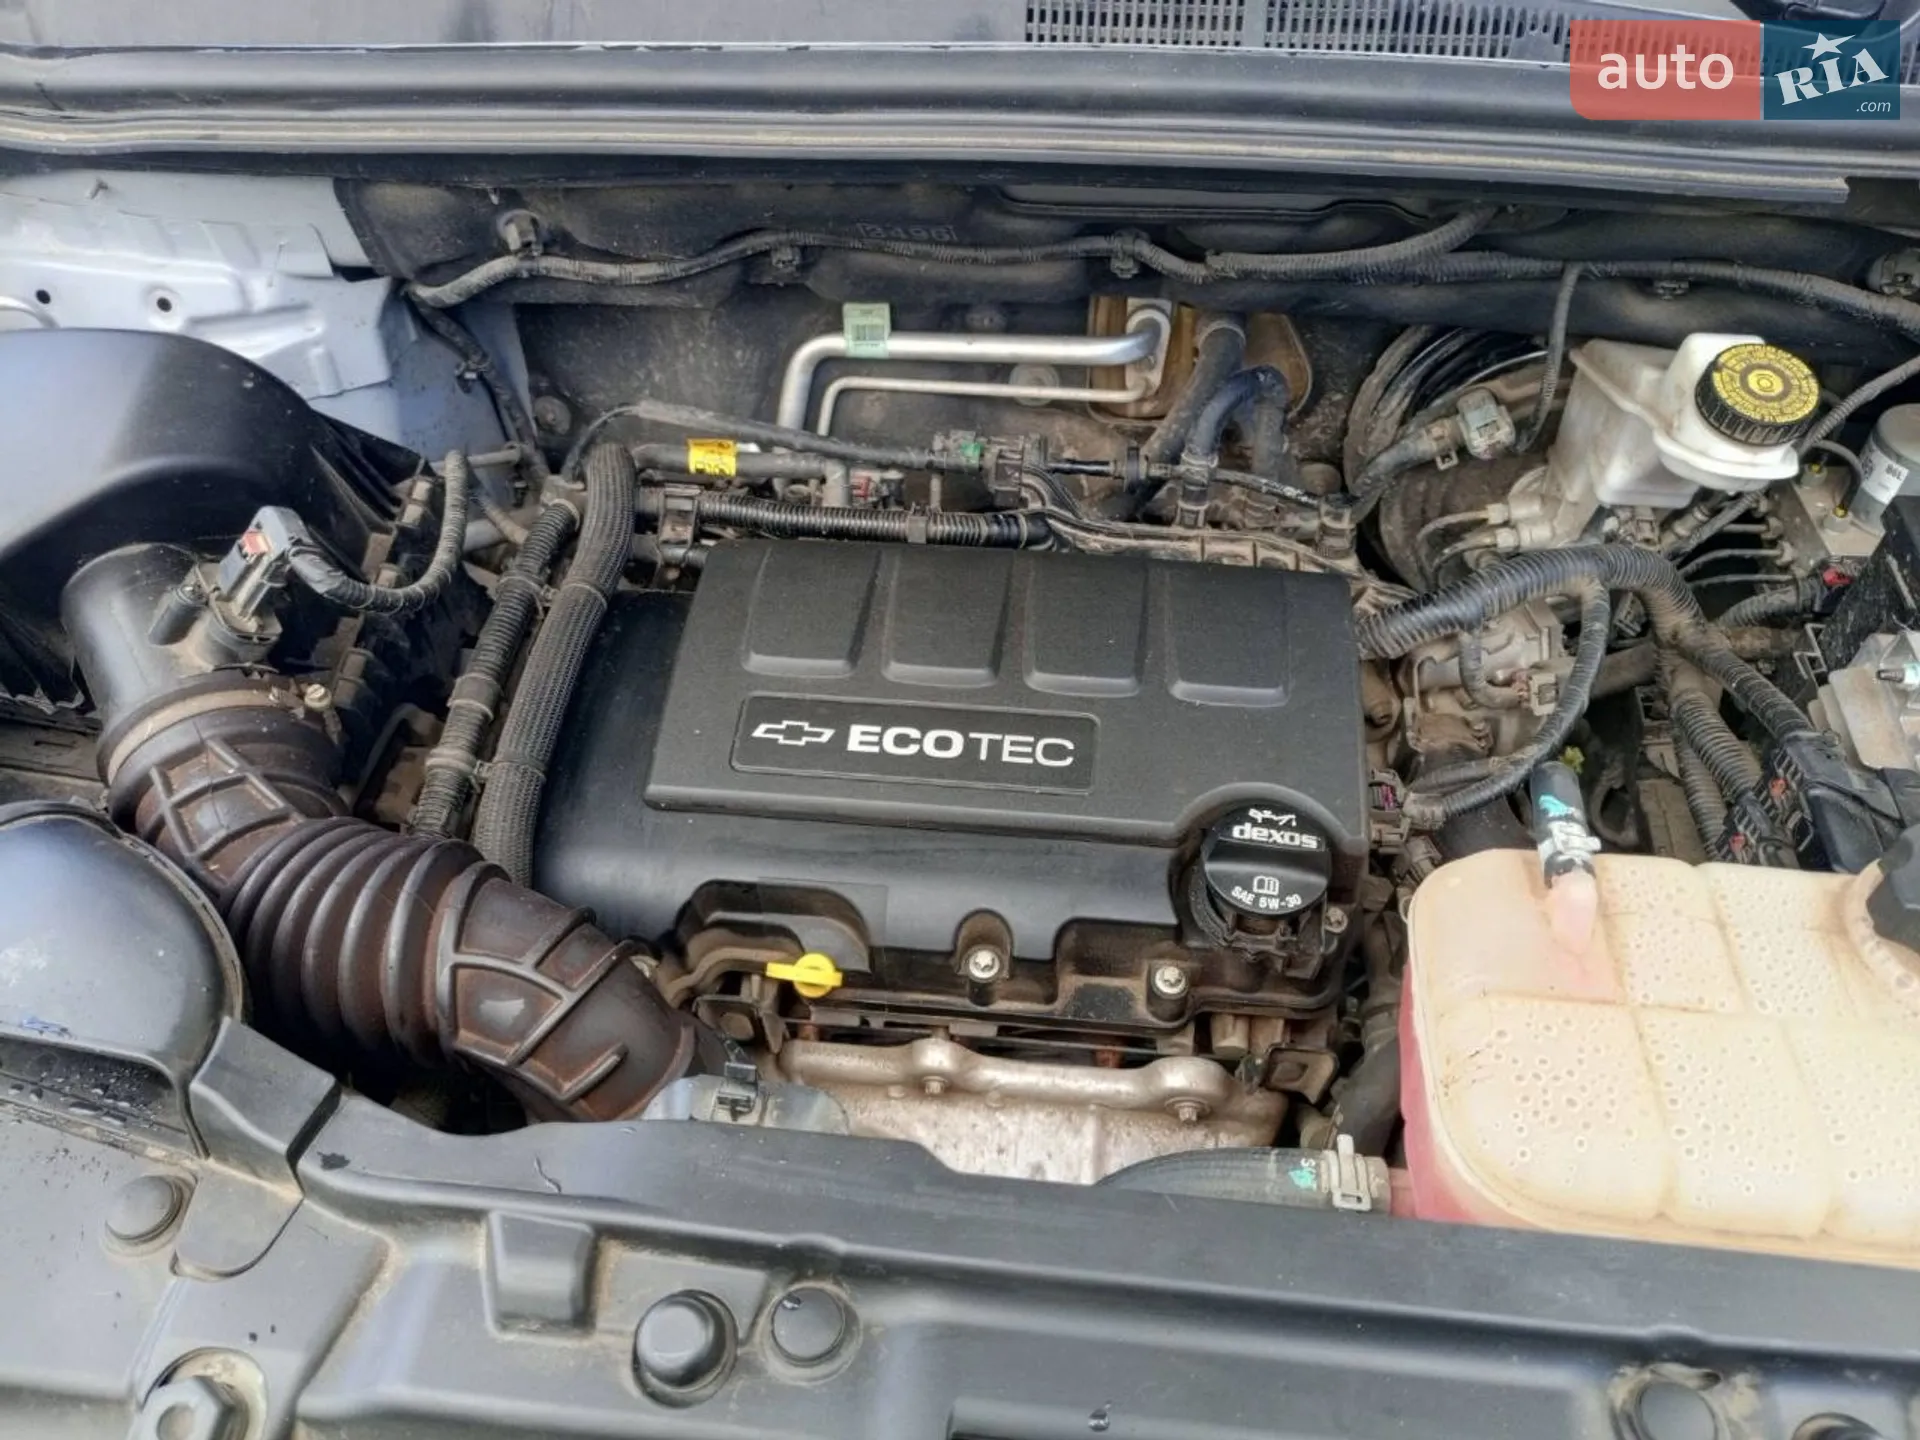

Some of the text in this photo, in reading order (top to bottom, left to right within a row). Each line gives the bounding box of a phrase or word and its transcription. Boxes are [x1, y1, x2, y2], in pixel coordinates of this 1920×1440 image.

[846, 724, 1075, 767] ECOTEC
[1232, 822, 1318, 849] dexos
[1231, 886, 1302, 910] SAE 5W-30
